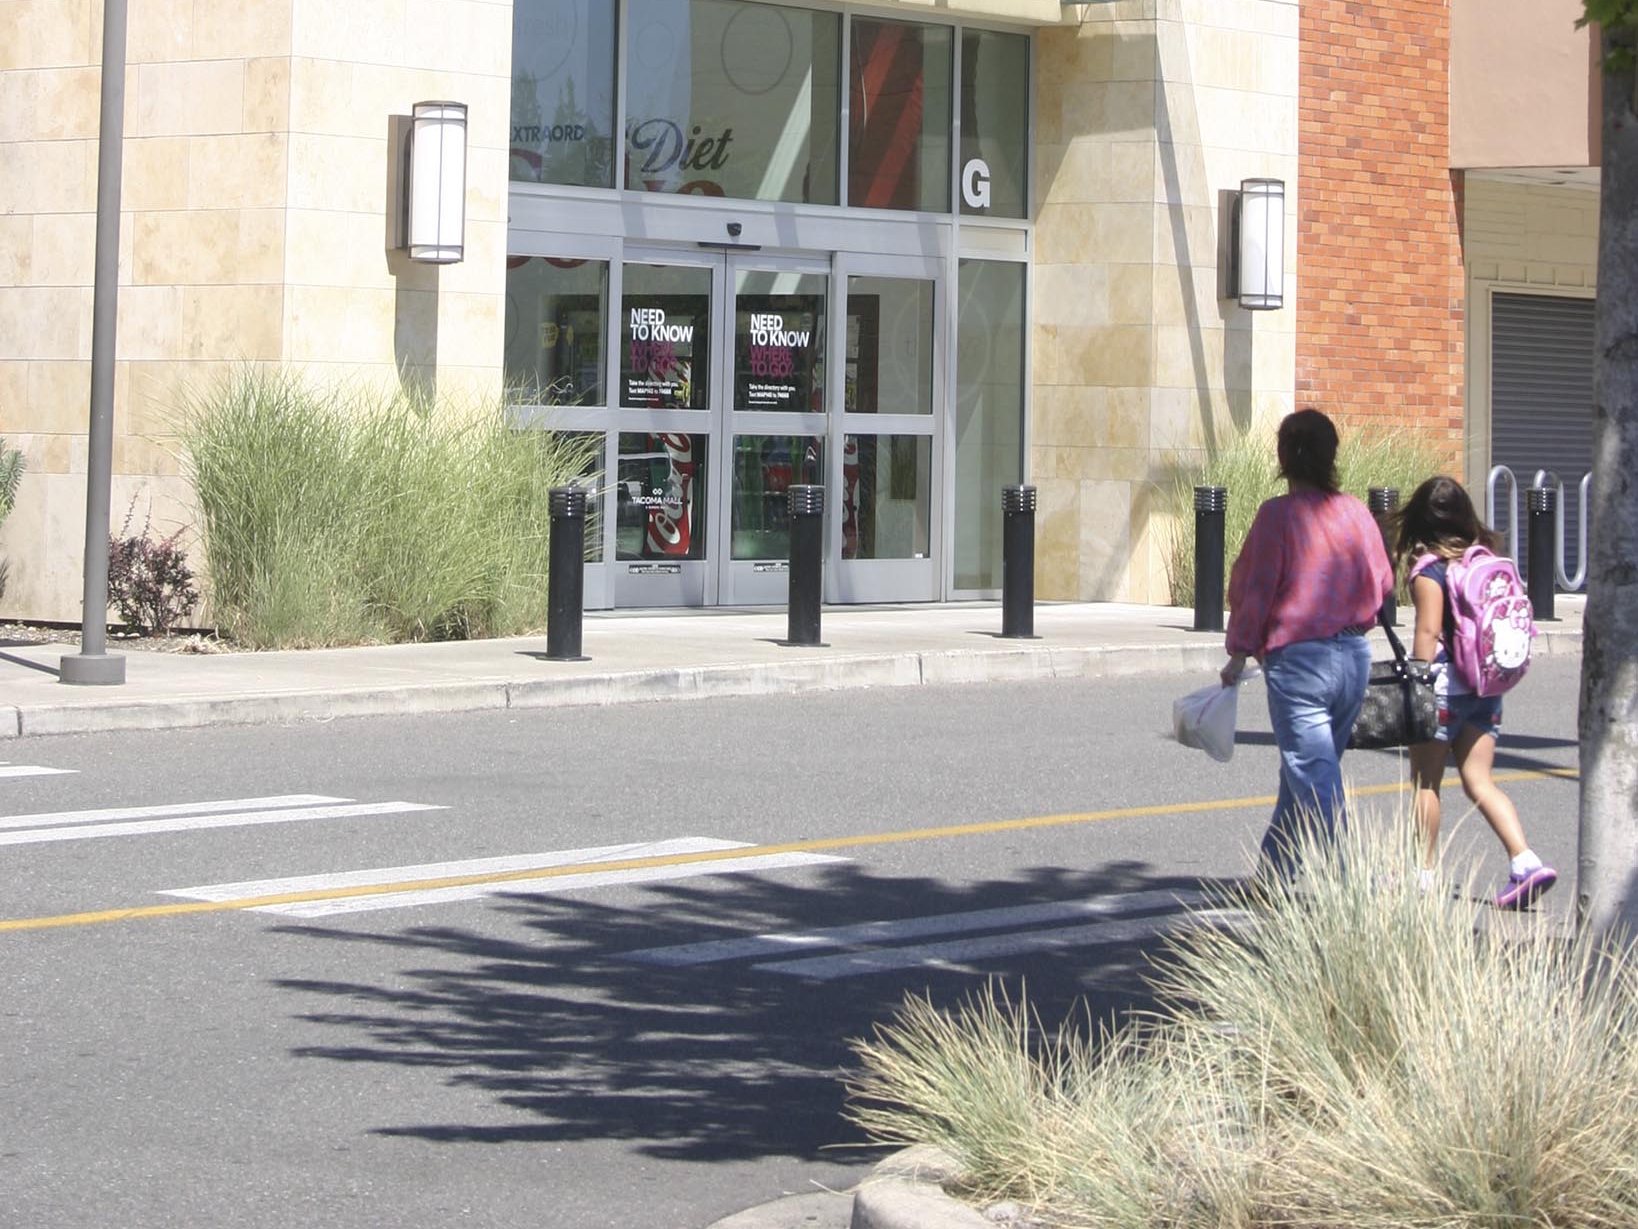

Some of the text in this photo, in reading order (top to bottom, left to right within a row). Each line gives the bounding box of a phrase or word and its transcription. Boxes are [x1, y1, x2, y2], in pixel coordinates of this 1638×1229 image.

[510, 125, 584, 143] XTRAORD
[632, 118, 733, 174] Diet
[962, 158, 991, 208] G
[630, 308, 665, 325] NEED
[750, 314, 783, 331] NEED
[630, 324, 693, 343] TO KNOW
[750, 329, 809, 347] TO KNOW
[630, 341, 673, 357] WHERE
[750, 346, 792, 362] WHERE
[750, 361, 767, 376] TO
[631, 496, 683, 505] TACOMA MALL
